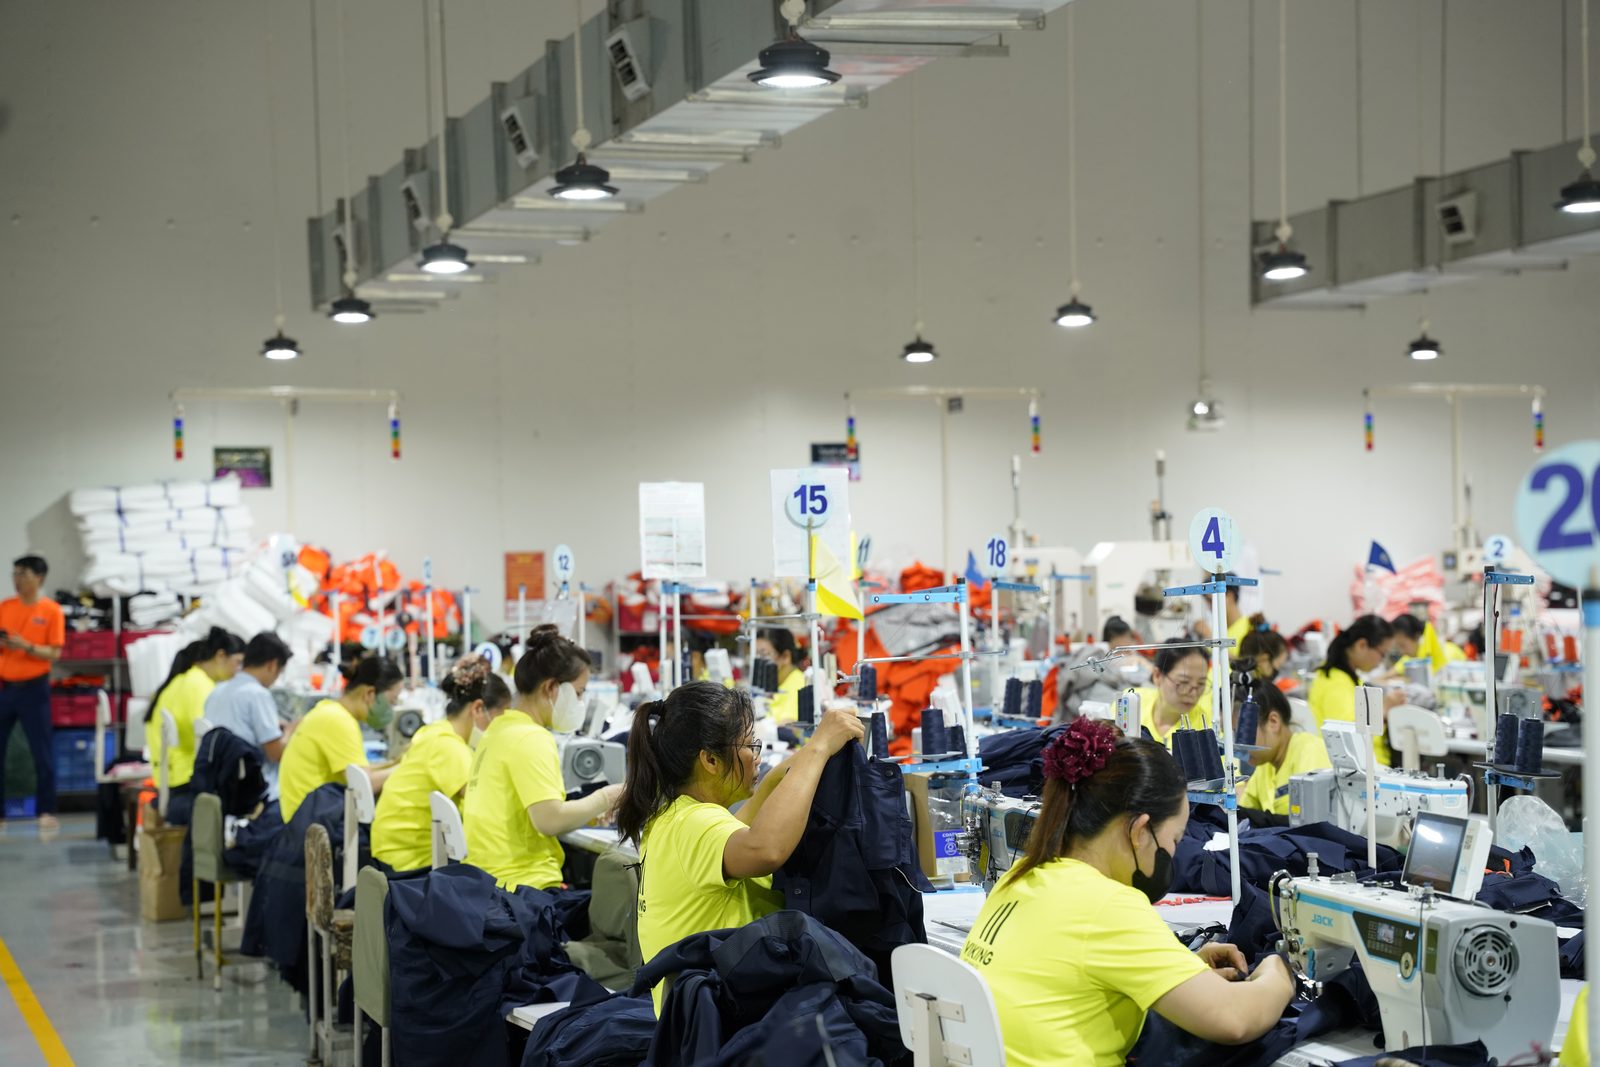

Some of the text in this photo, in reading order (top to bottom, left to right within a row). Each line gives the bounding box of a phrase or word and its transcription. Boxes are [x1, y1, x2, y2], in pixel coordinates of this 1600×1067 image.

[793, 484, 828, 515] 15
[1530, 462, 1600, 553] 2
[857, 537, 871, 563] 11
[1201, 516, 1225, 559] 4
[1493, 540, 1504, 558] 2
[558, 554, 569, 571] 12
[987, 538, 1006, 568] 18
[1311, 913, 1334, 928] JACK
[964, 940, 994, 966] VIKING
